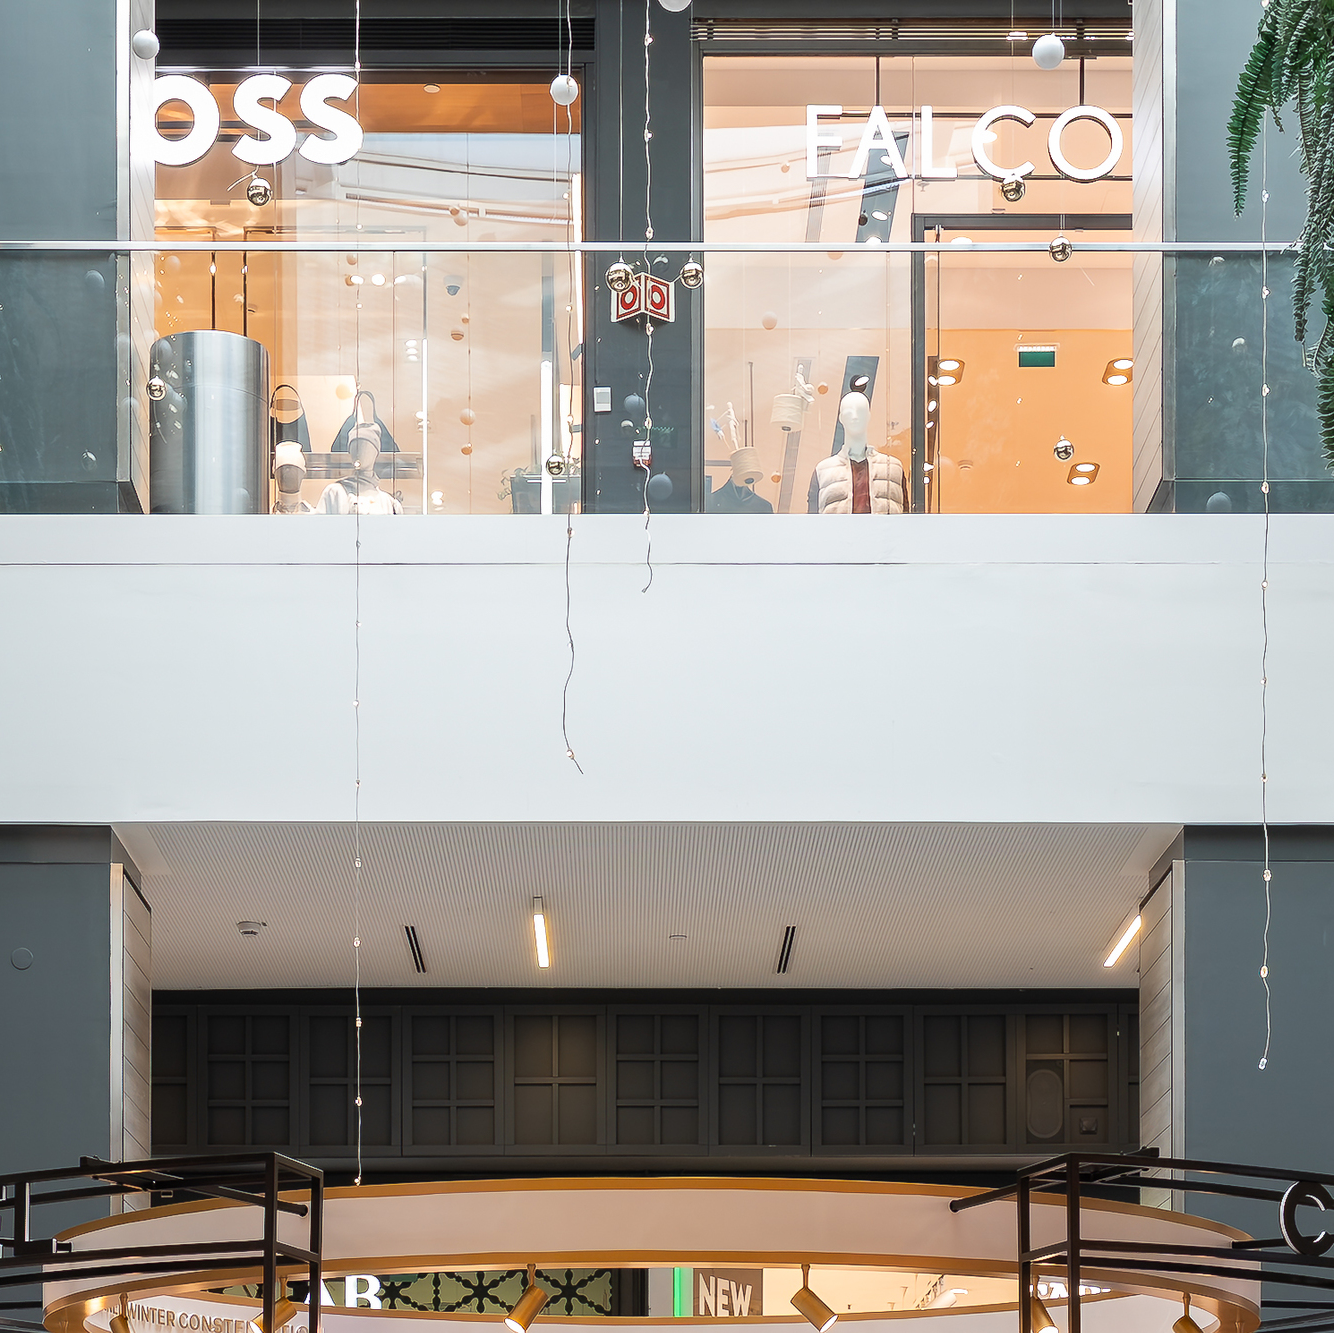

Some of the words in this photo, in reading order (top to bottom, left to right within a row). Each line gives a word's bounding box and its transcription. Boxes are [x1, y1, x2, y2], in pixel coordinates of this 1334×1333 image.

[806, 104, 1124, 183] FALCO
[128, 1302, 175, 1327] WINTER
[699, 1273, 752, 1317] NEW
